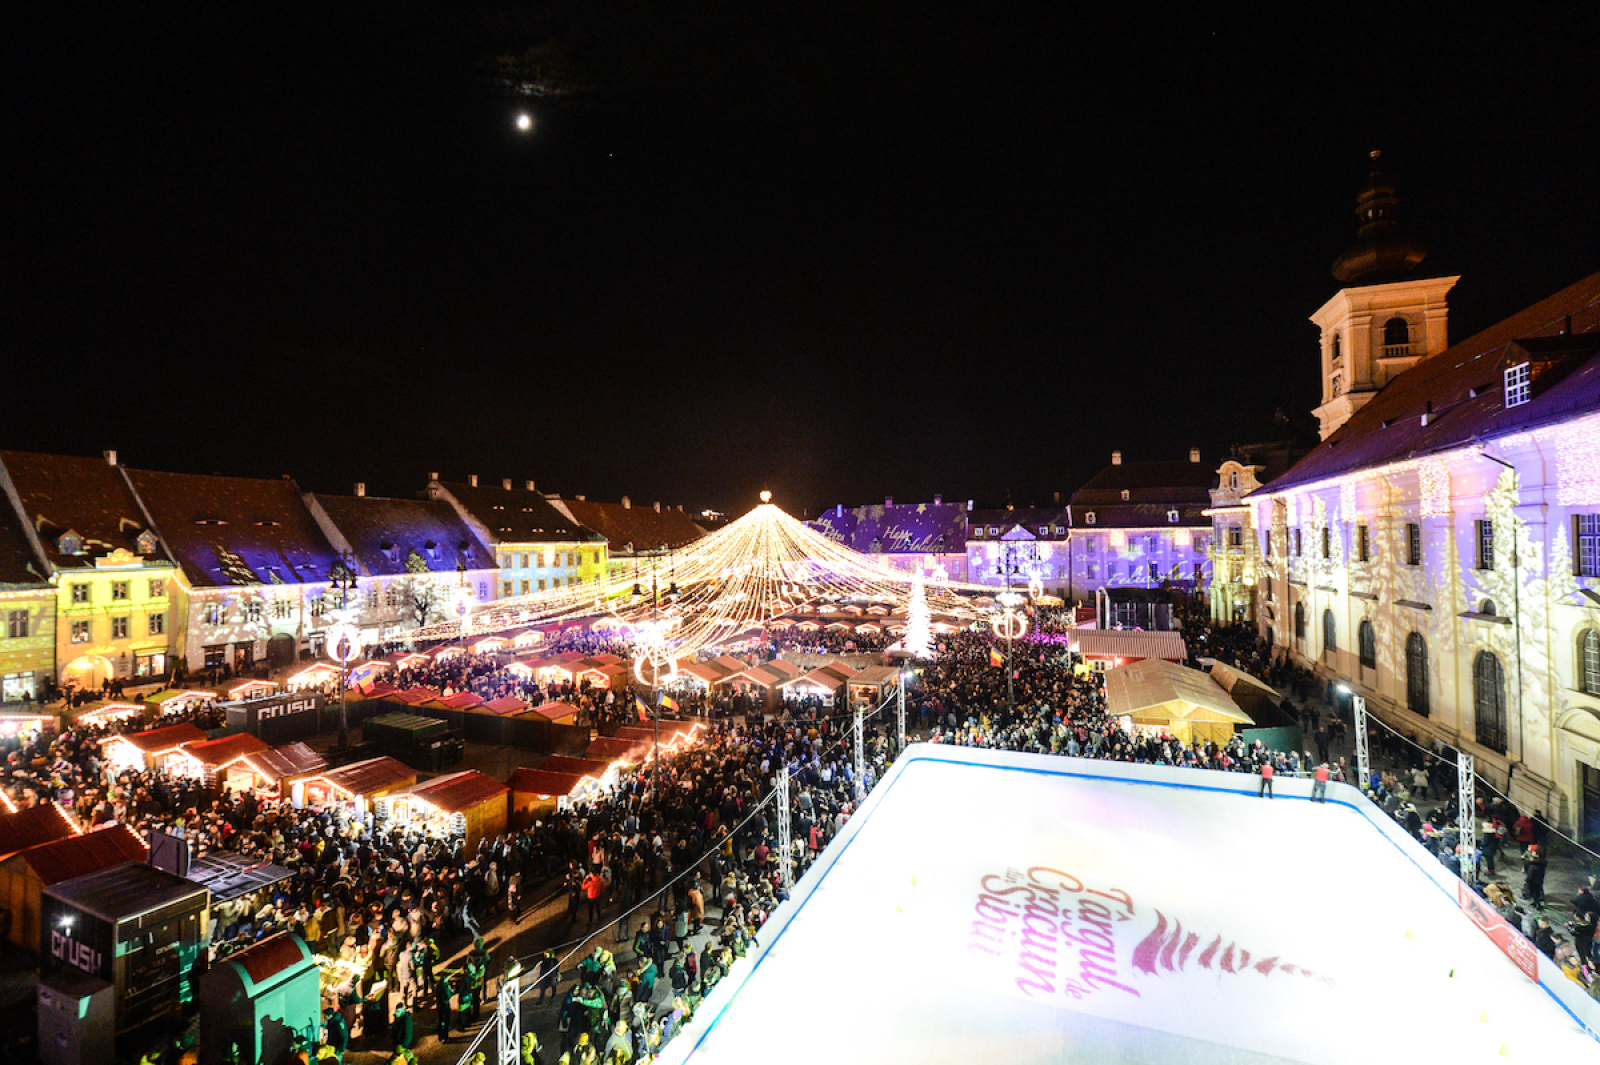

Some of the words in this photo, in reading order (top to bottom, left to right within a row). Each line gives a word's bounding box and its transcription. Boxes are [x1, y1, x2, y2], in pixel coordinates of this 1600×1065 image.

[967, 875, 1036, 958] Sibiu
[1014, 866, 1085, 998] Crăciun
[1060, 887, 1141, 998] Târgul
